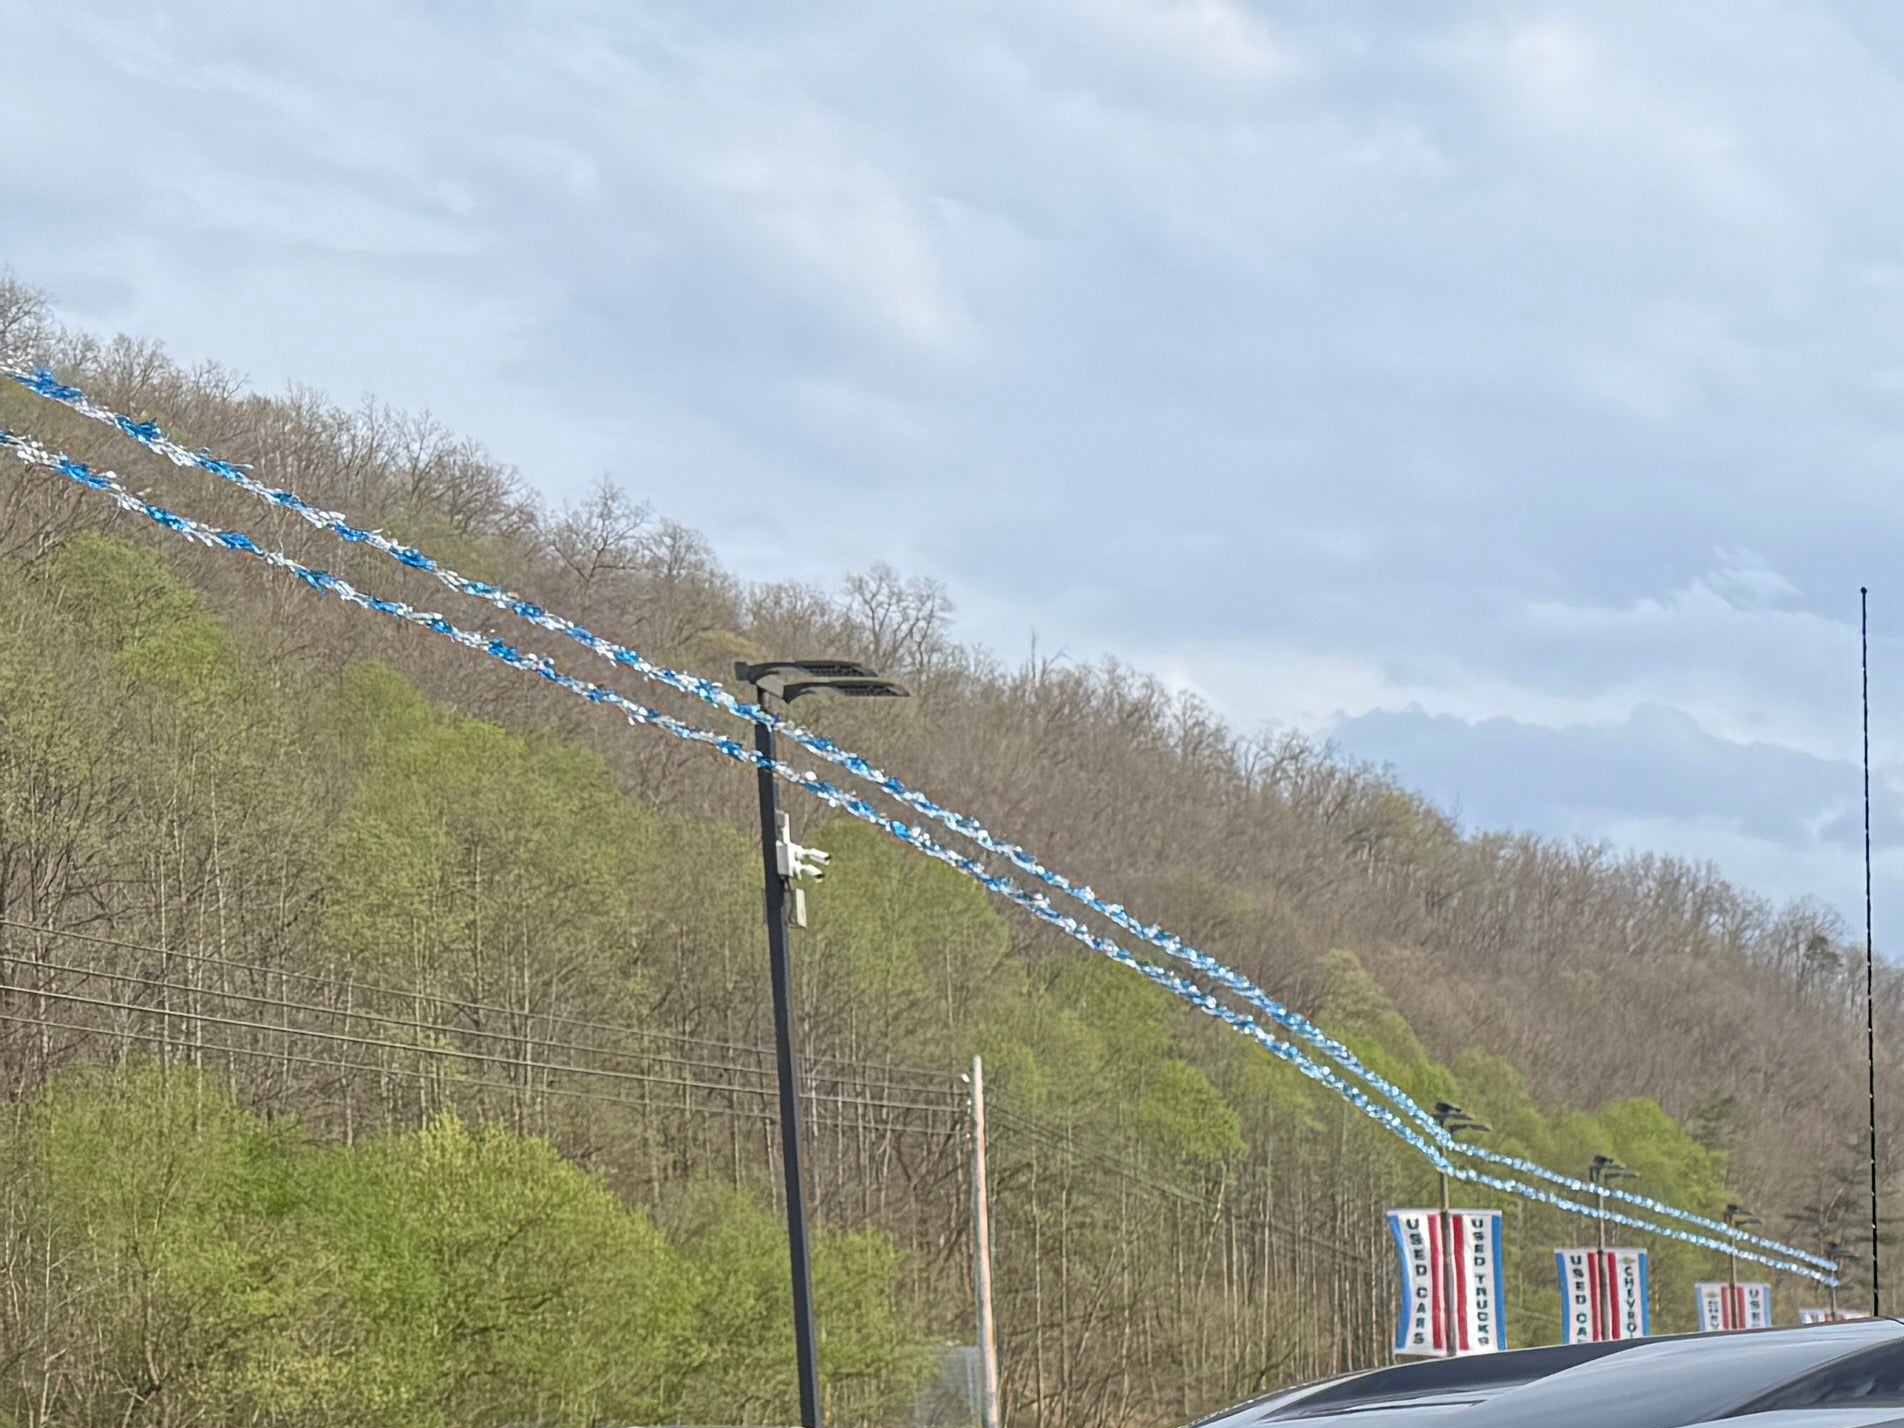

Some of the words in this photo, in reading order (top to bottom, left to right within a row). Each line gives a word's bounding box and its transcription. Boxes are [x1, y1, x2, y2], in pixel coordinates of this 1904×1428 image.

[1406, 1218, 1428, 1277] USED
[1471, 1218, 1486, 1267] USED
[1570, 1255, 1588, 1305] USED
[1413, 1286, 1429, 1345] CARS
[1474, 1274, 1490, 1346] TRUCKS
